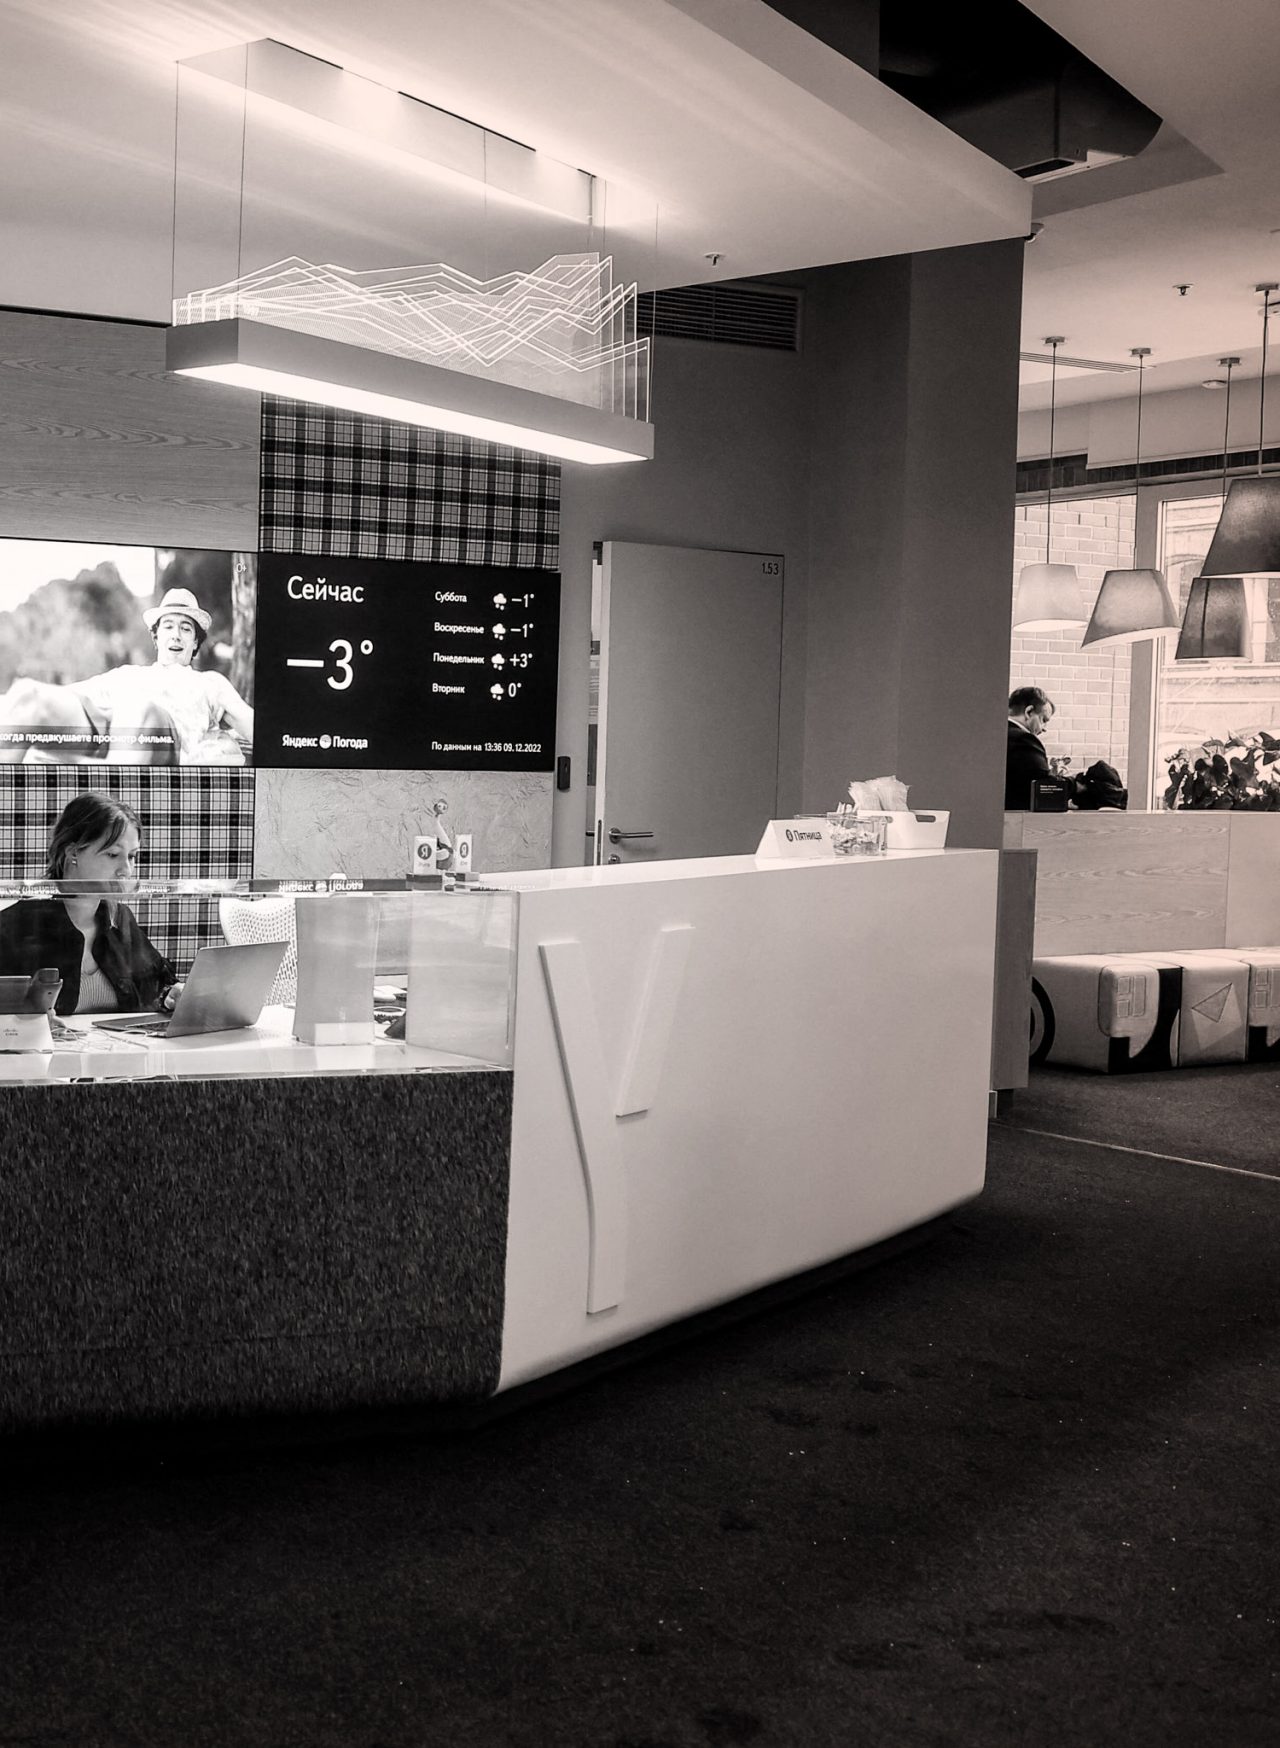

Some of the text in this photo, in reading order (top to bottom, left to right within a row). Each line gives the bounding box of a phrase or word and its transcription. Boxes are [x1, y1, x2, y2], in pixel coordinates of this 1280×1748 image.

[236, 563, 247, 573] 0+
[287, 575, 365, 603] Сейчас
[434, 591, 468, 604] Суббота
[434, 621, 485, 635] Воскресенье
[286, 639, 375, 691] -3°
[433, 652, 533, 668] Понедельник +3°
[432, 683, 522, 698] Вторник 0°
[25, 733, 92, 744] предвкушаете
[93, 734, 137, 745] просмотр
[138, 733, 175, 745] фильма.
[282, 734, 369, 750] Яндекс Погода
[431, 741, 442, 750] По
[443, 743, 472, 752] данным
[473, 744, 482, 752] на
[484, 743, 502, 752] 13:36
[793, 829, 823, 842] Пятница
